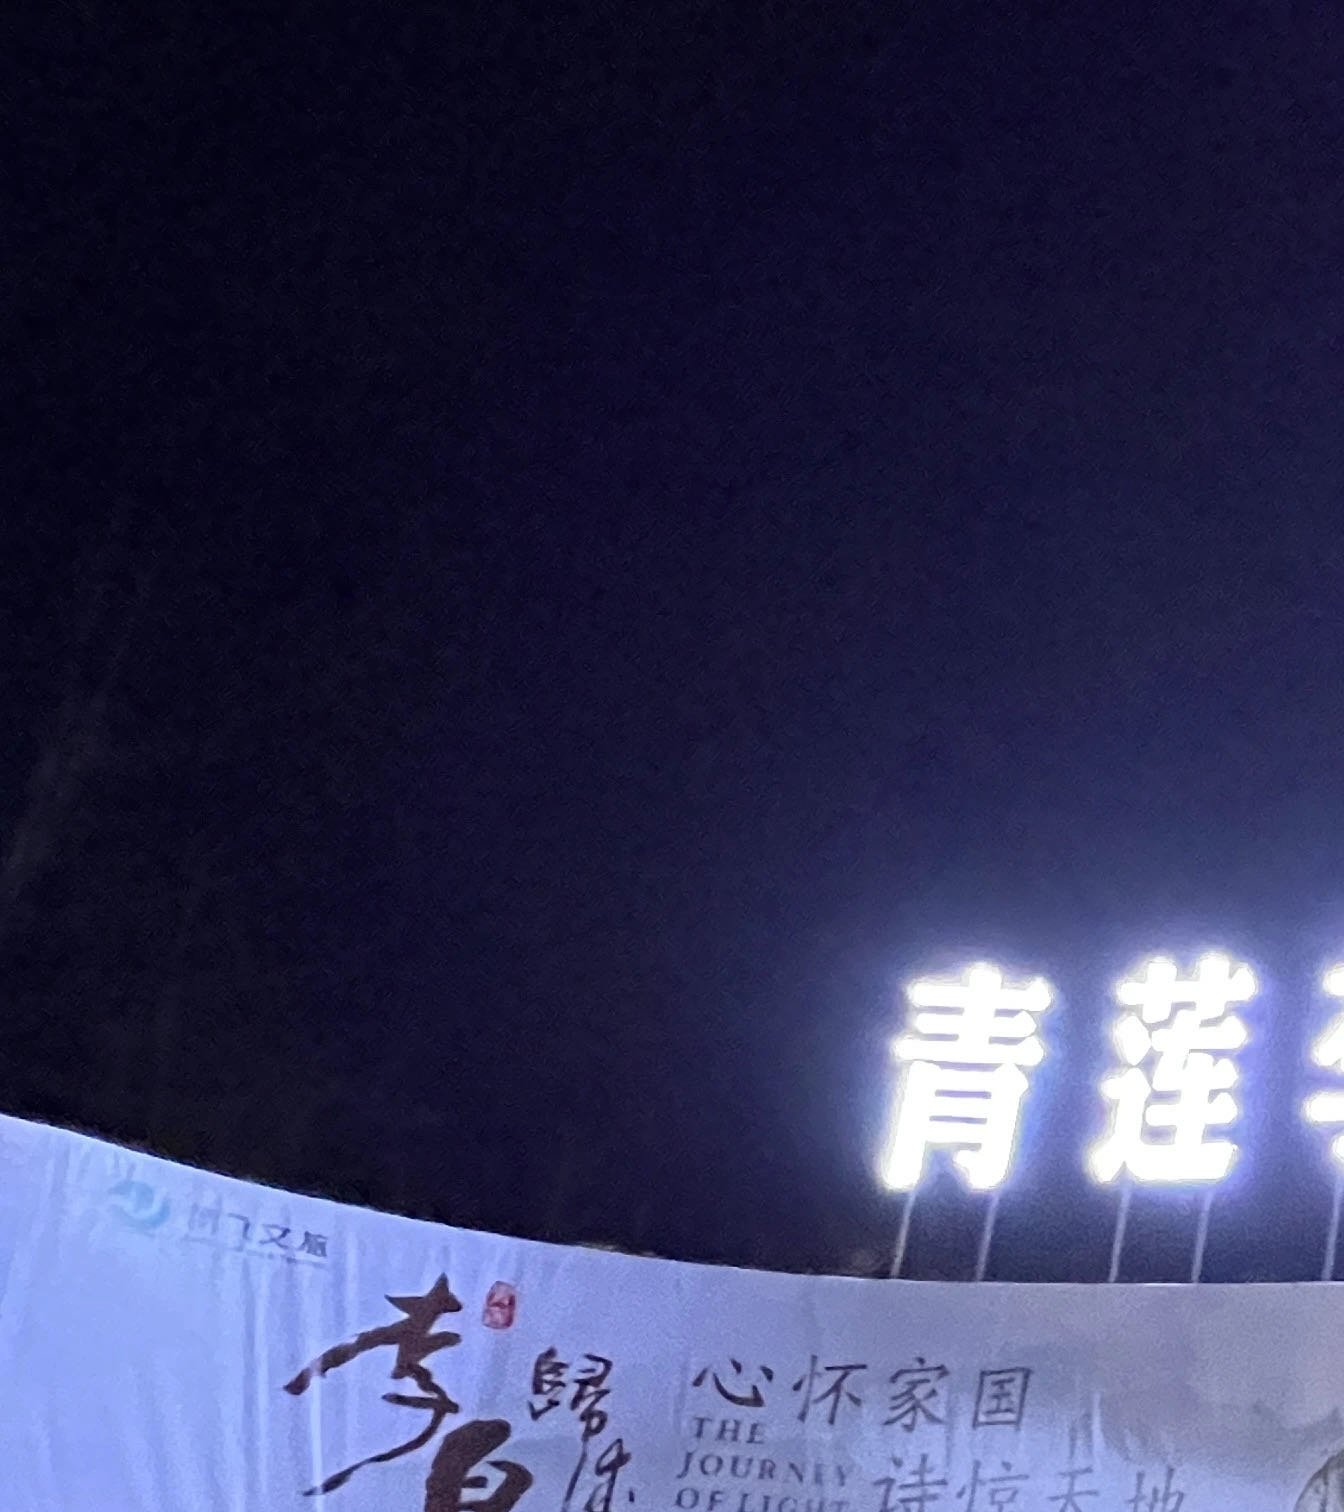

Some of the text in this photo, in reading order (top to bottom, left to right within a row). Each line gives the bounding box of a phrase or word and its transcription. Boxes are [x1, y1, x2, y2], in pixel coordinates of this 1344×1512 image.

[691, 1354, 1035, 1431] 心怀家国
[694, 1417, 767, 1445] THE
[674, 1487, 725, 1512] OF
